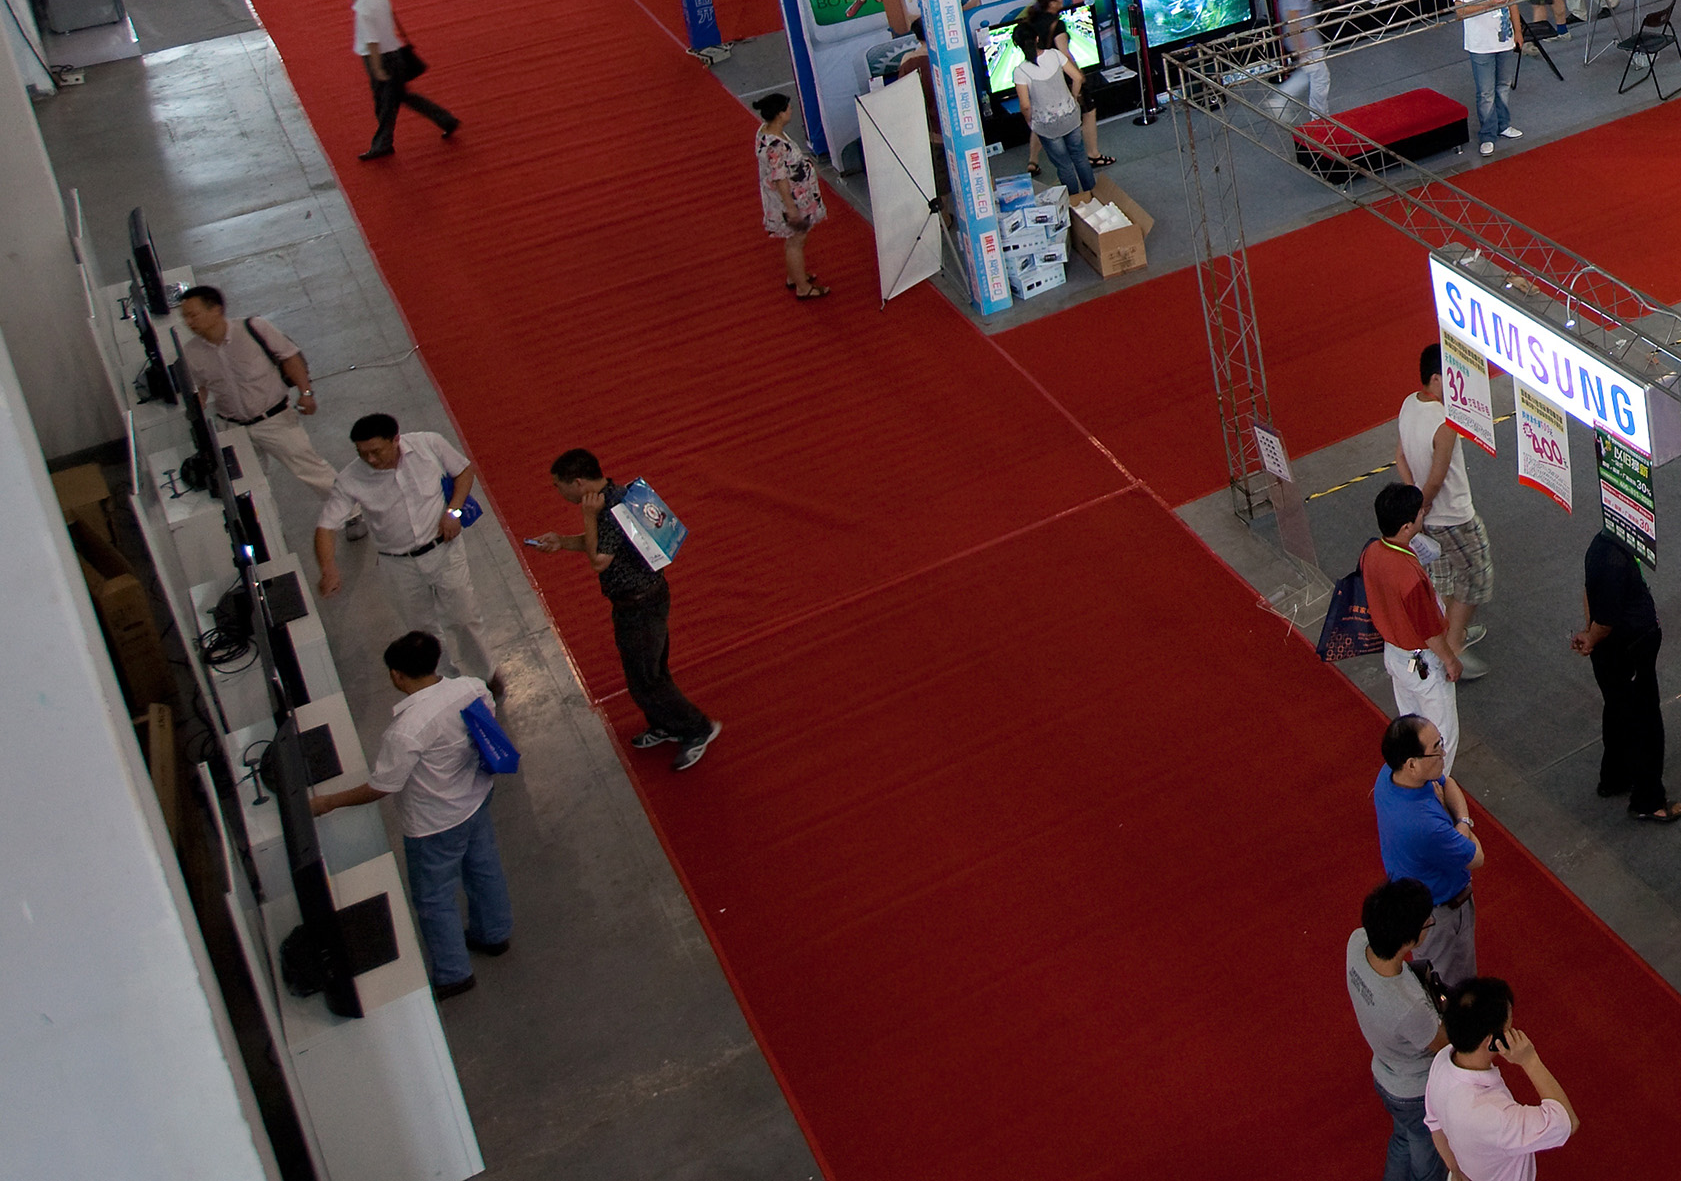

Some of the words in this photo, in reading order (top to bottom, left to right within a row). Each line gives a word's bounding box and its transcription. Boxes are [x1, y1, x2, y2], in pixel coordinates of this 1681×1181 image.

[1445, 281, 1636, 436] SAMSUNG
[1447, 367, 1467, 406] 32
[1532, 433, 1563, 465] 400
[1636, 479, 1652, 497] 30%
